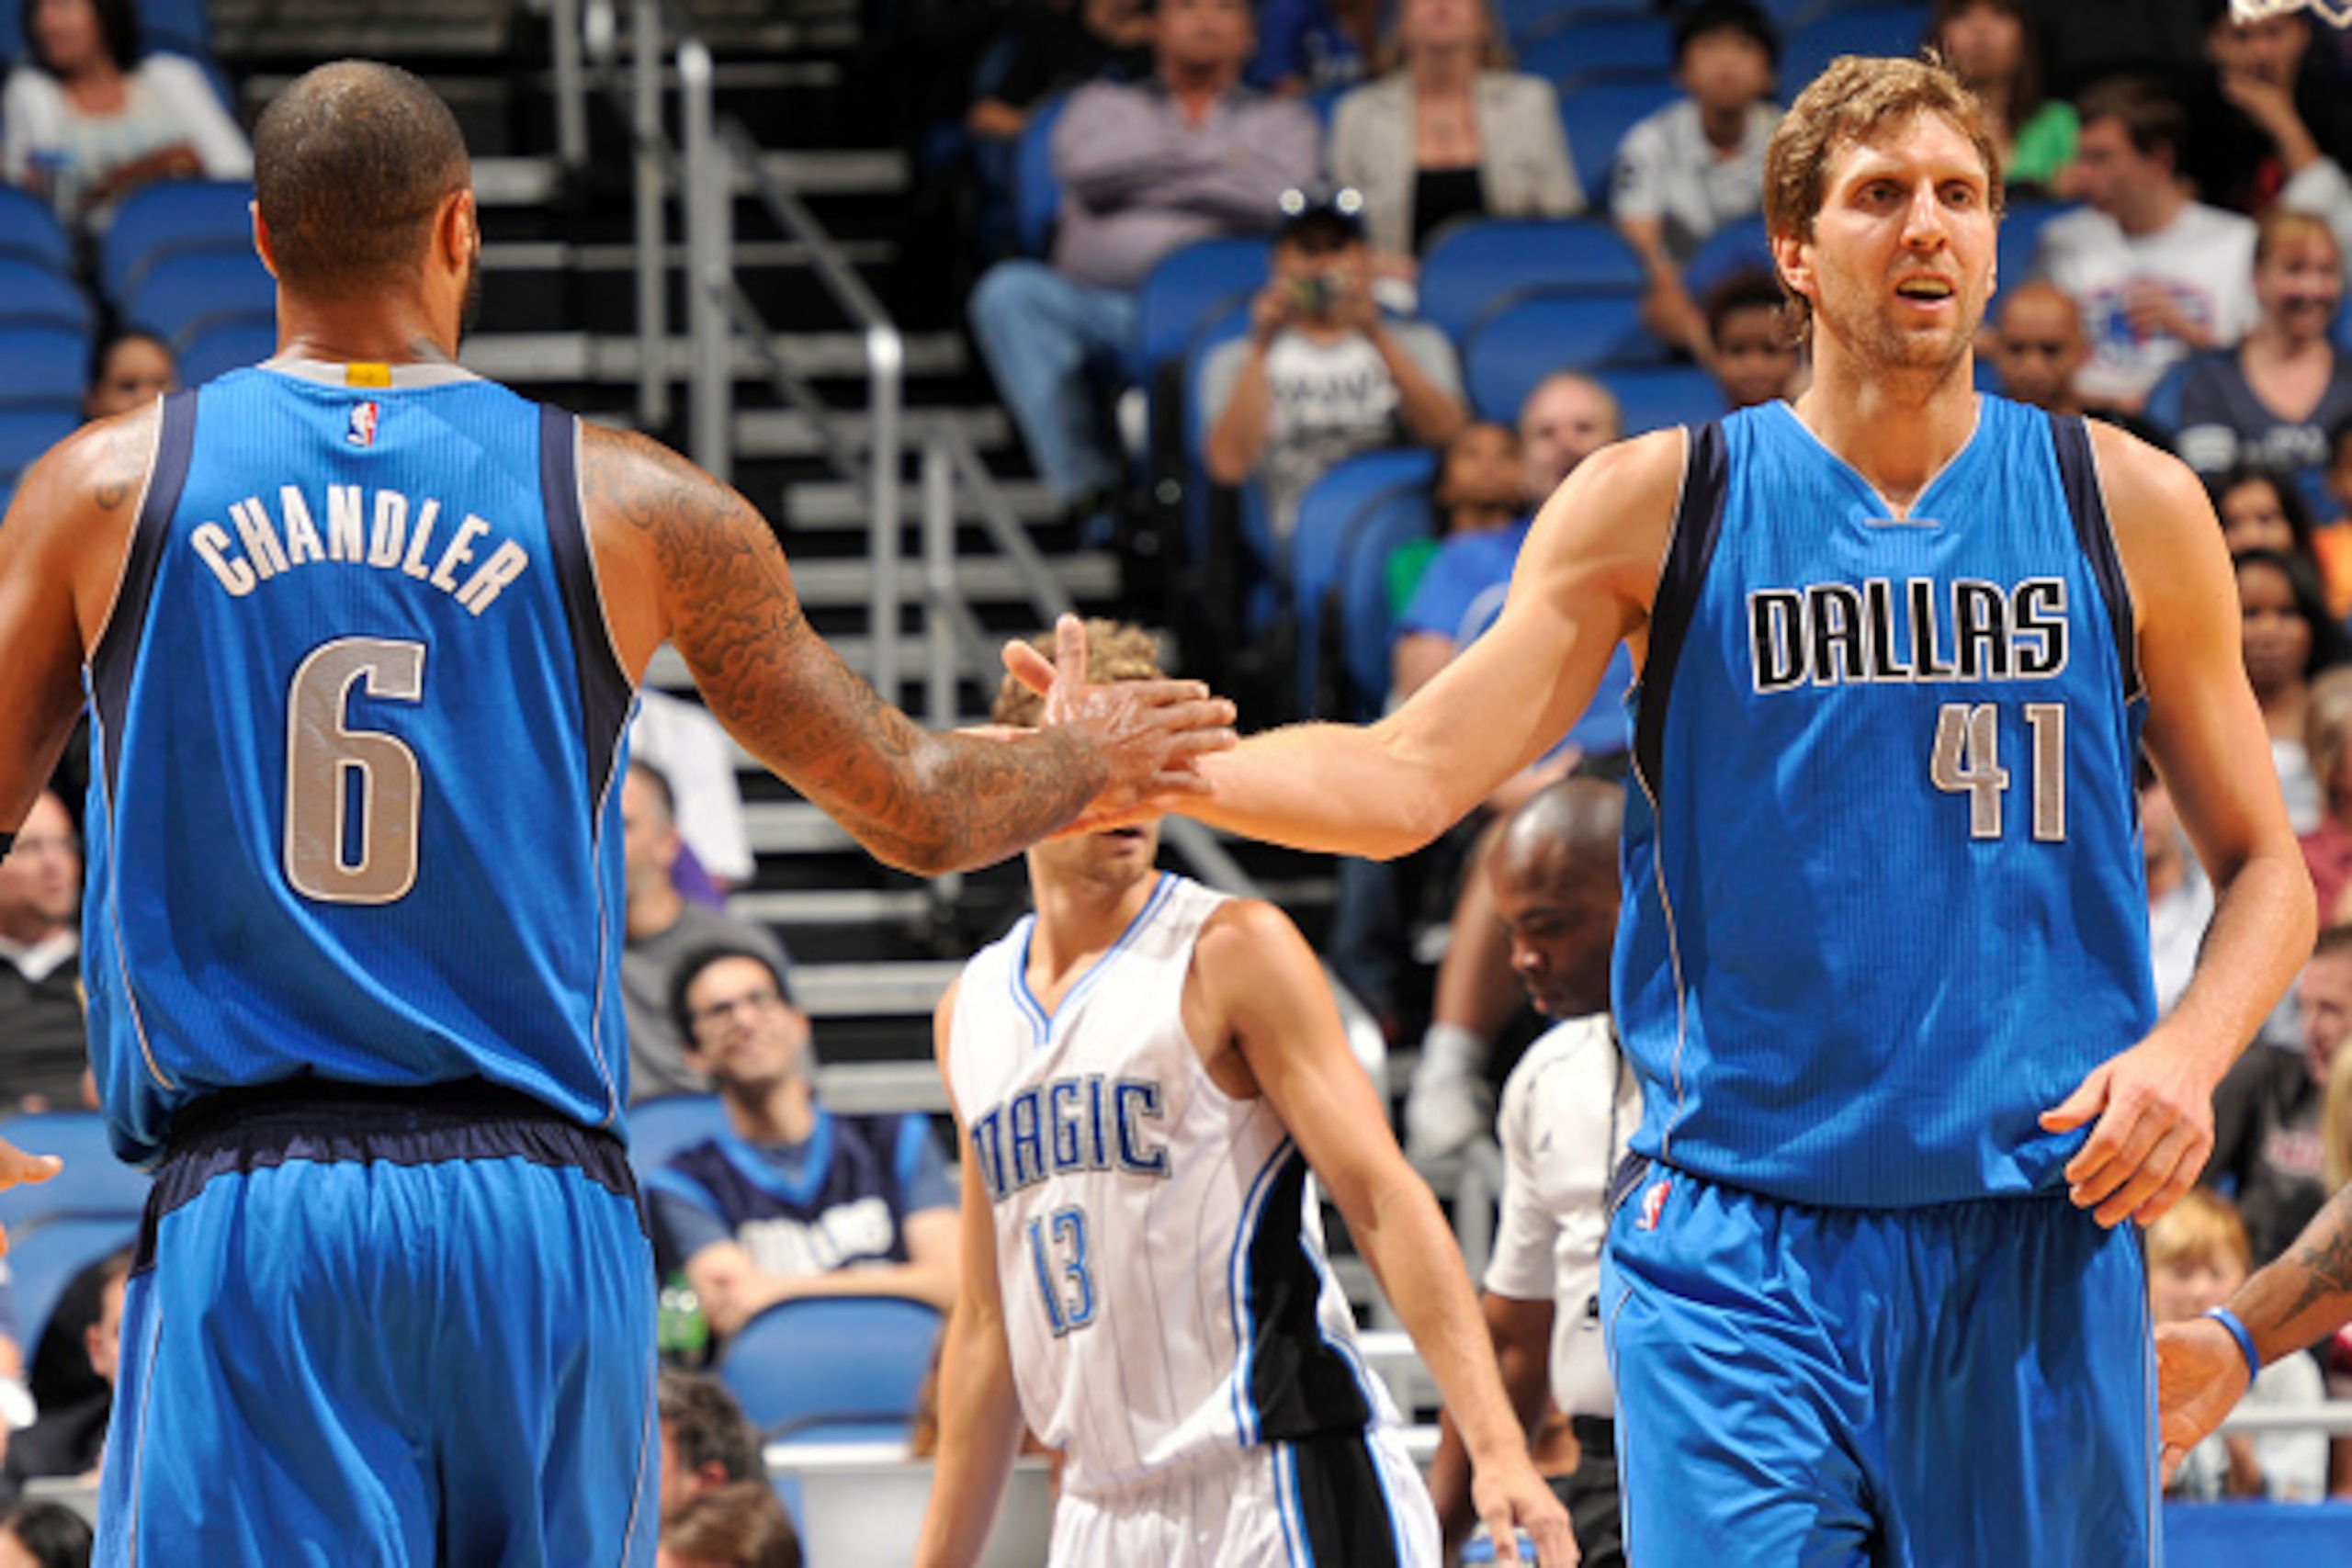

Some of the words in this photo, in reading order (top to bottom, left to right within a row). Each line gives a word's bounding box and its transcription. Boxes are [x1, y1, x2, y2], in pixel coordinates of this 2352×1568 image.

[190, 482, 529, 616] CHANDLER
[1748, 577, 2068, 694] DALLAS
[285, 636, 425, 905] 6
[1930, 702, 2066, 841] 41
[971, 1073, 1171, 1204] MAGIC
[1028, 1204, 1097, 1339] 13
